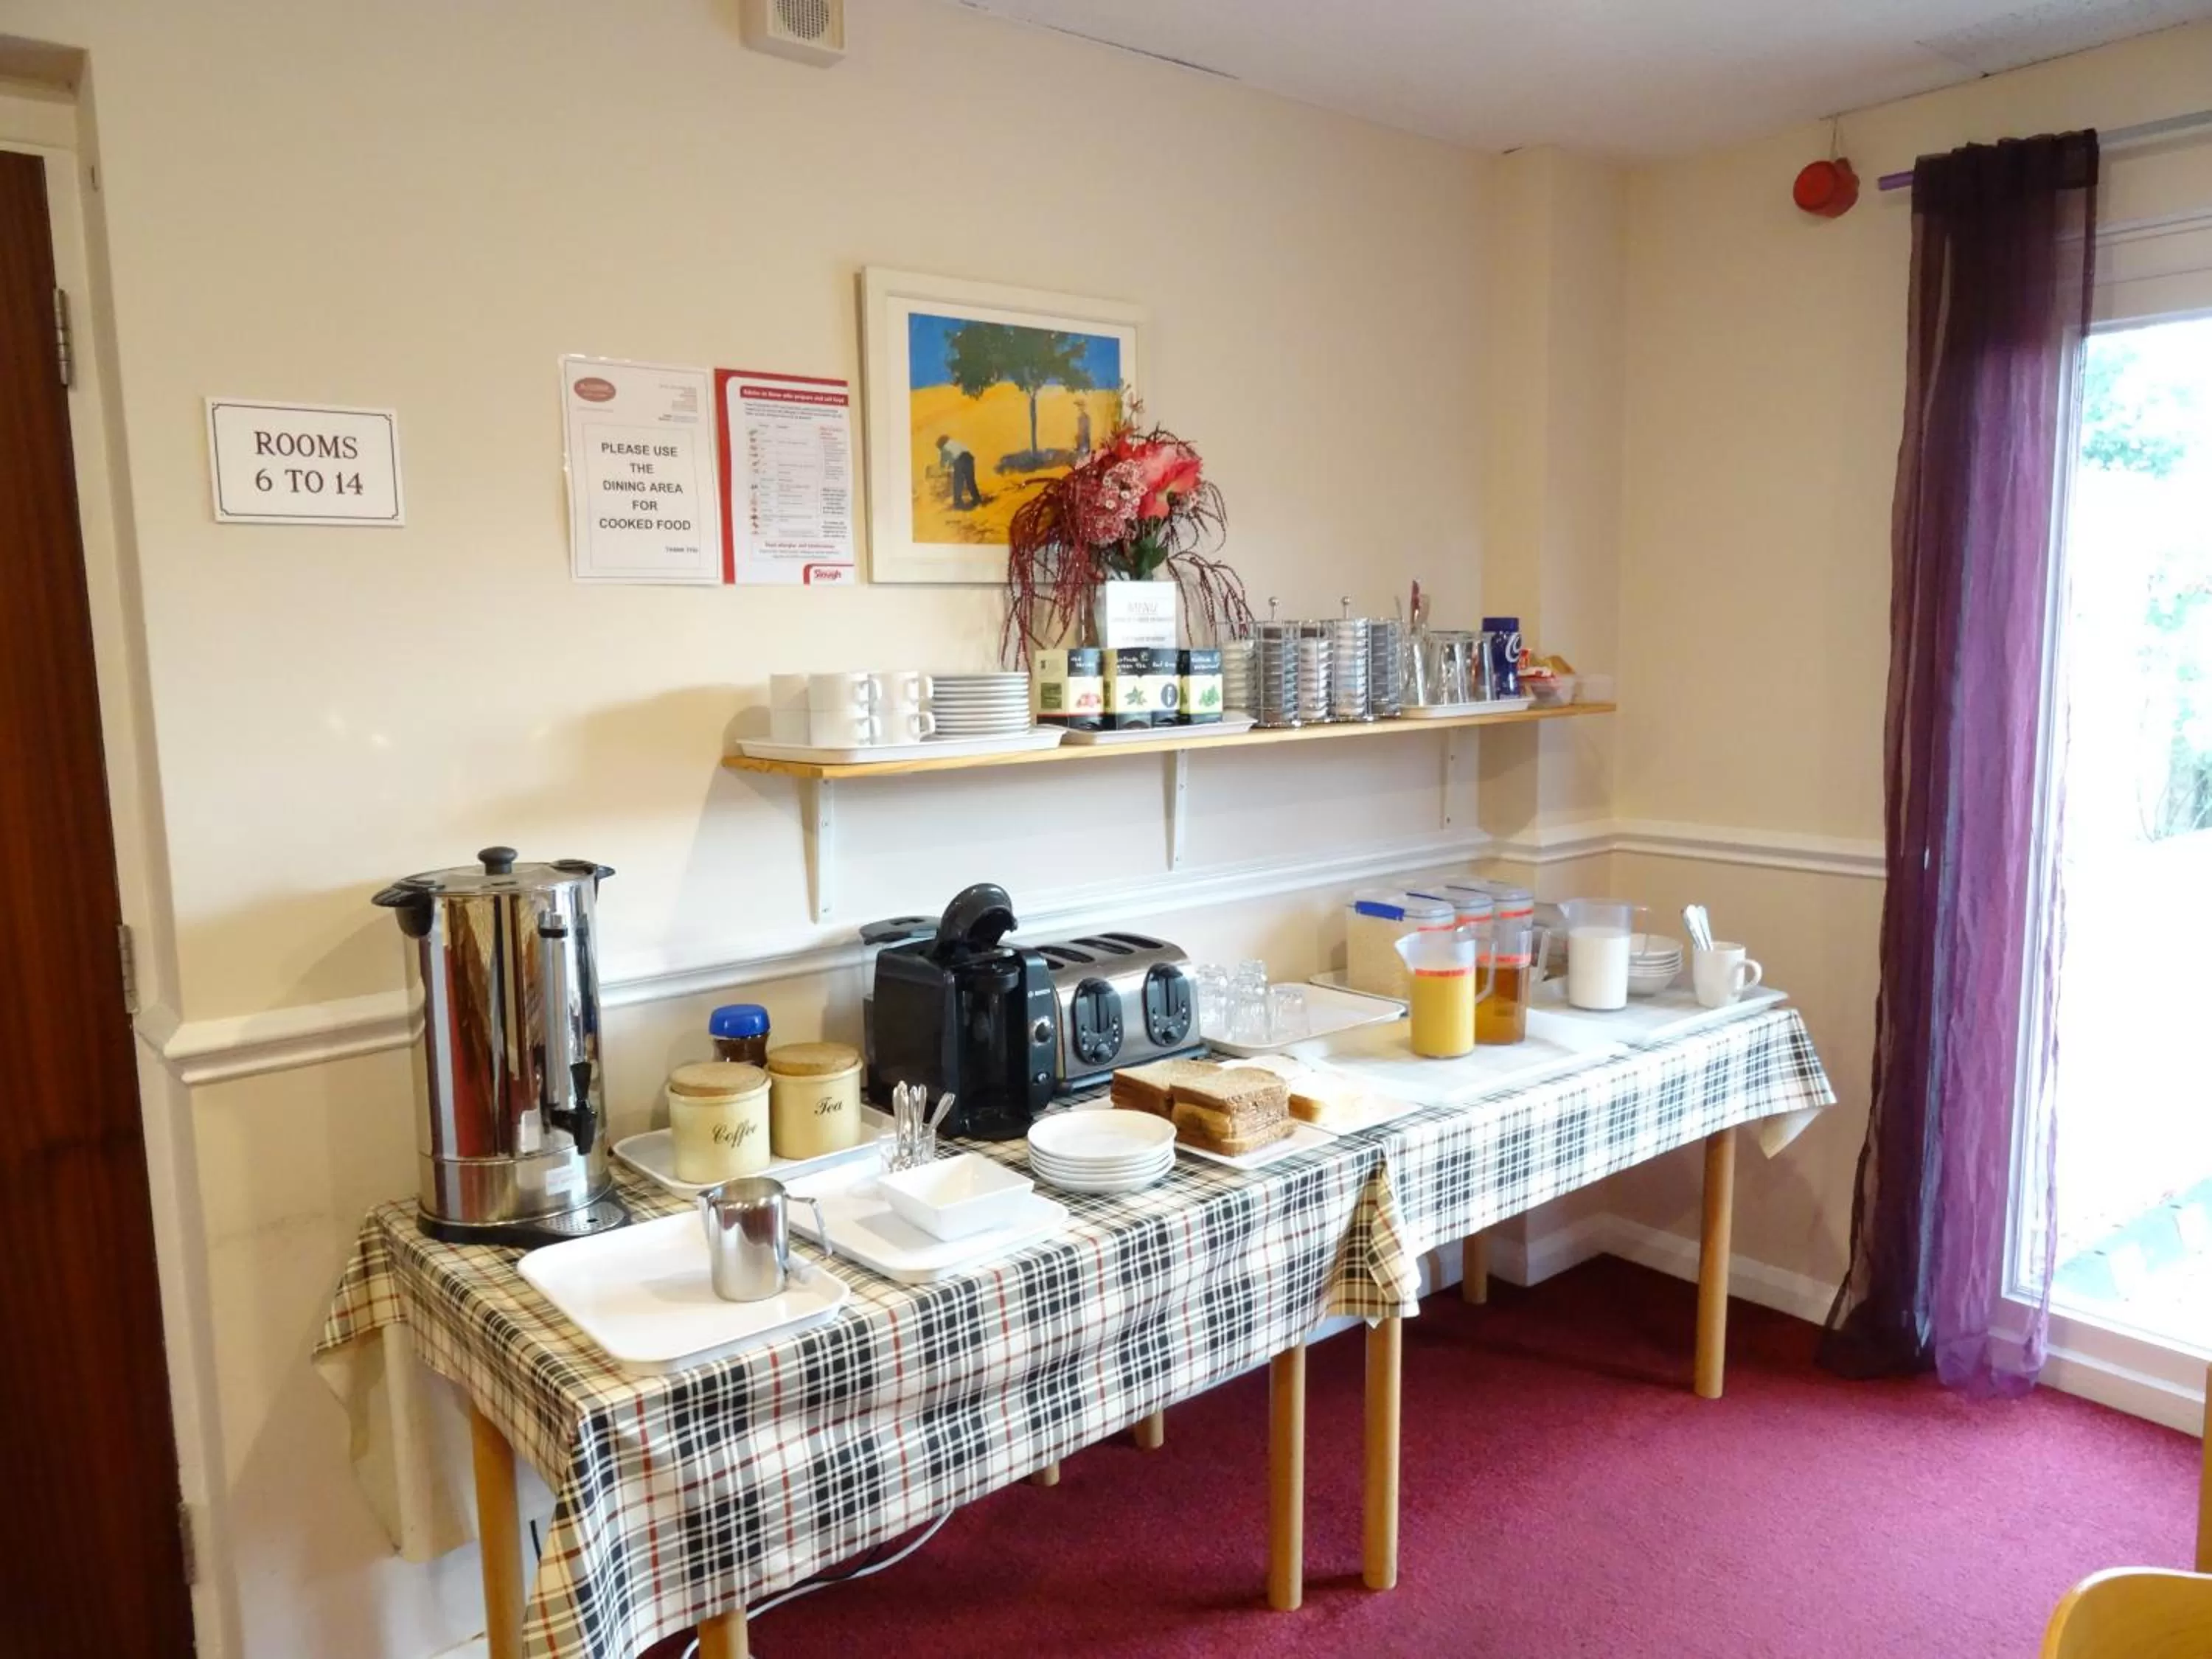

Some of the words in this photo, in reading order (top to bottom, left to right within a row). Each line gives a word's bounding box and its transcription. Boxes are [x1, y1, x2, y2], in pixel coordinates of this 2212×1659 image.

[254, 431, 358, 459] ROOMS
[601, 442, 650, 456] PLEASE
[653, 445, 678, 457] USE
[630, 463, 655, 473] THE
[255, 468, 273, 492] 6
[285, 469, 324, 493] TO
[335, 471, 364, 495] 14
[602, 480, 646, 492] DINING
[650, 483, 684, 494] AREA
[632, 500, 658, 511] FOR
[599, 518, 653, 529] COOKED
[657, 520, 691, 531] FOOD
[814, 568, 841, 580] Slough
[814, 1096, 844, 1115] Tea
[712, 1119, 758, 1149] Coffee
